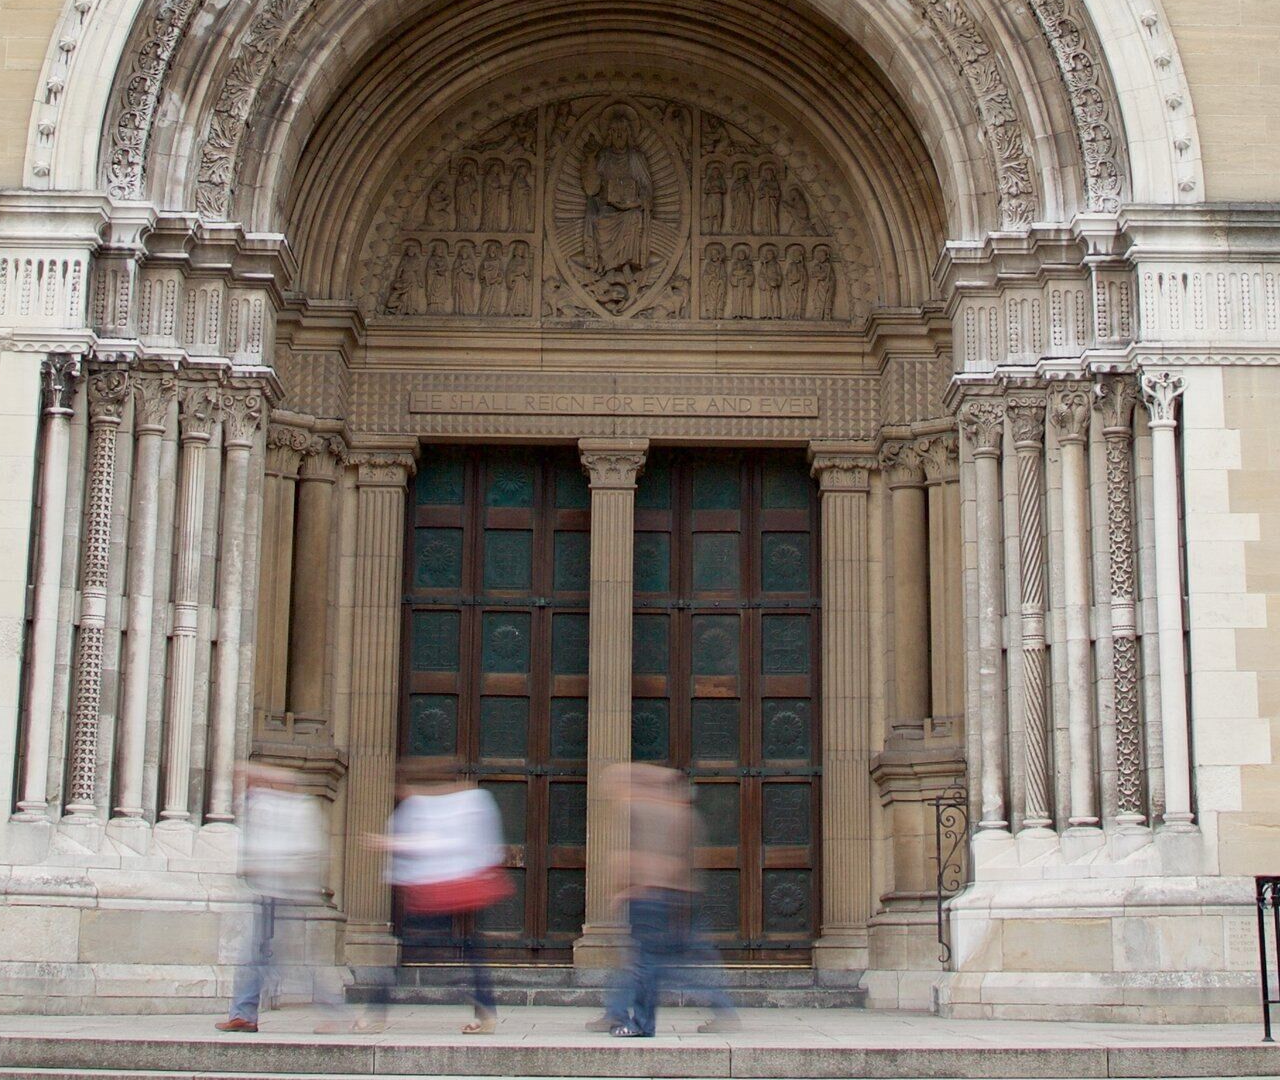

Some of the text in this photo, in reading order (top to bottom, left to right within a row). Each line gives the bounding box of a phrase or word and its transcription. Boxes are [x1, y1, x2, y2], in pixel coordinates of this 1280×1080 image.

[414, 394, 814, 414] HE SHALL REIGN FOR EVER AND EVER
